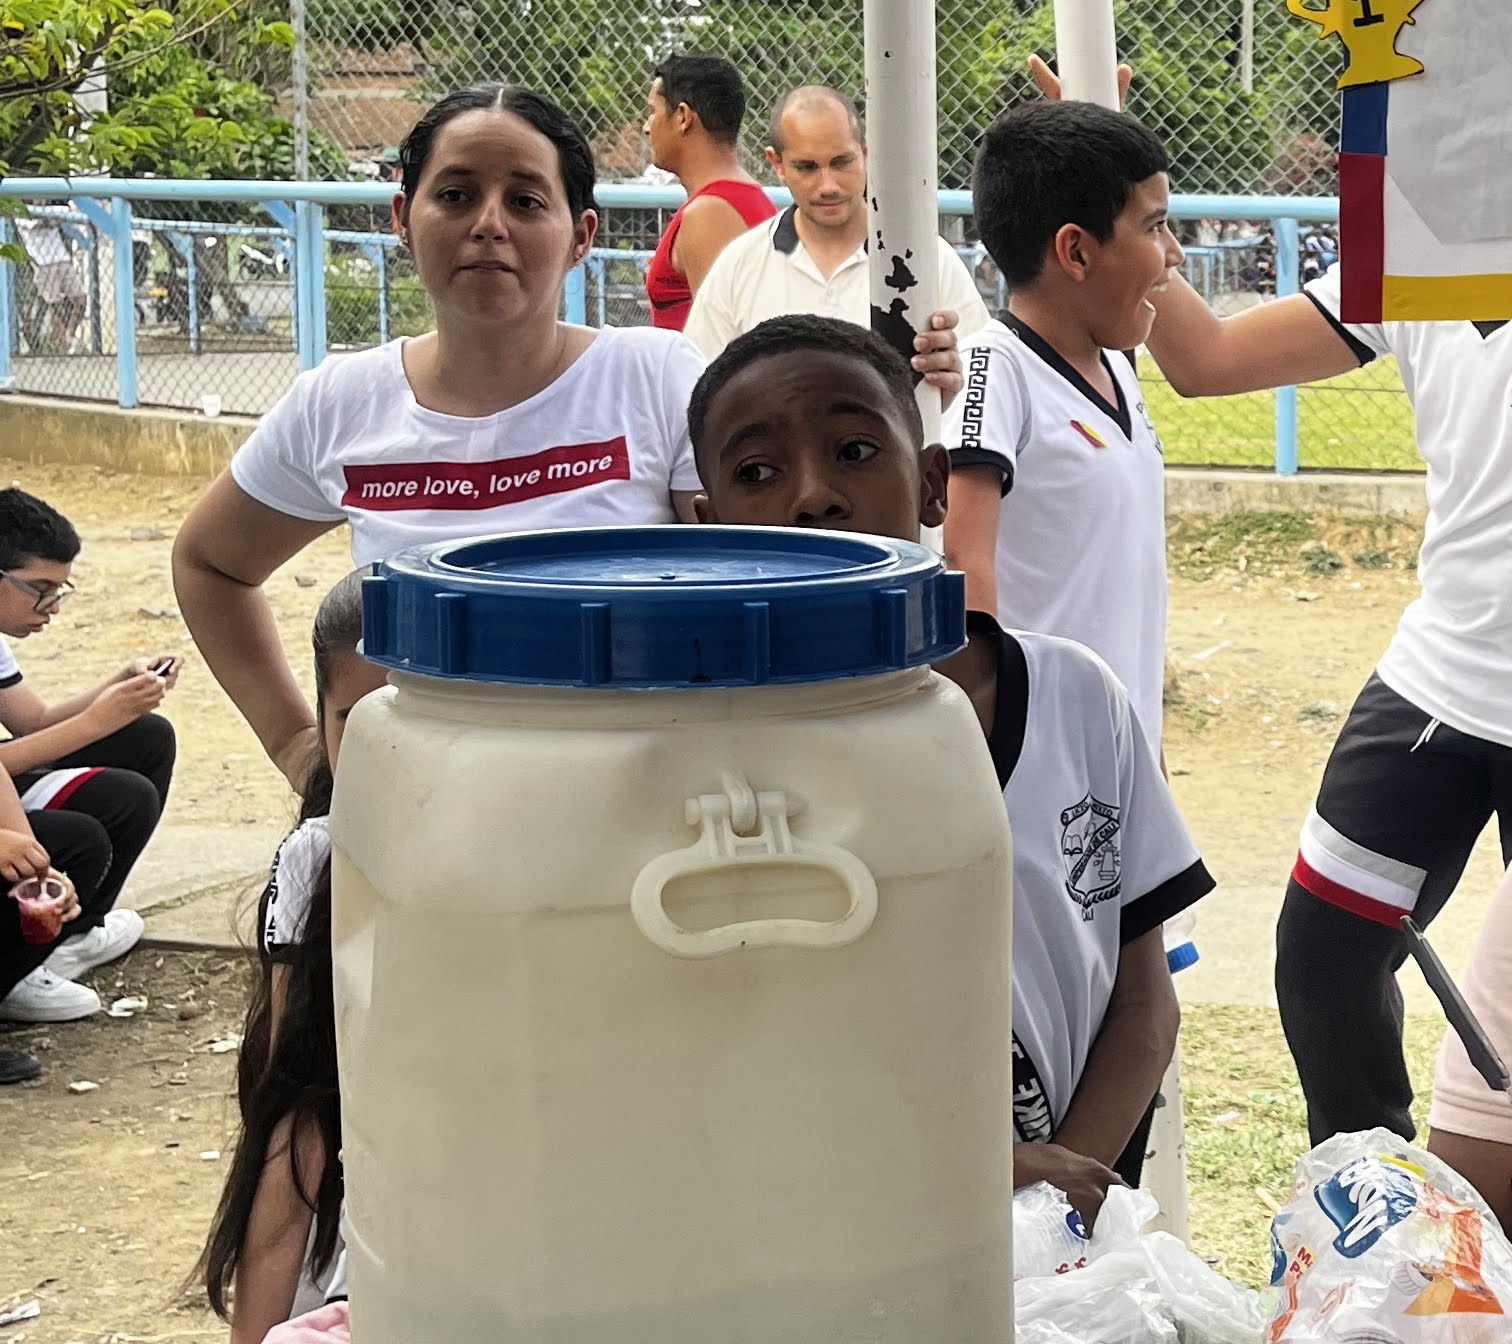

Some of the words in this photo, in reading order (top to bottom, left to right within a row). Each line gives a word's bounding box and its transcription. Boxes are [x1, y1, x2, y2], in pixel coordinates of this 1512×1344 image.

[361, 479, 418, 498] more
[423, 475, 480, 499] love,
[489, 468, 540, 494] love
[547, 455, 613, 480] more
